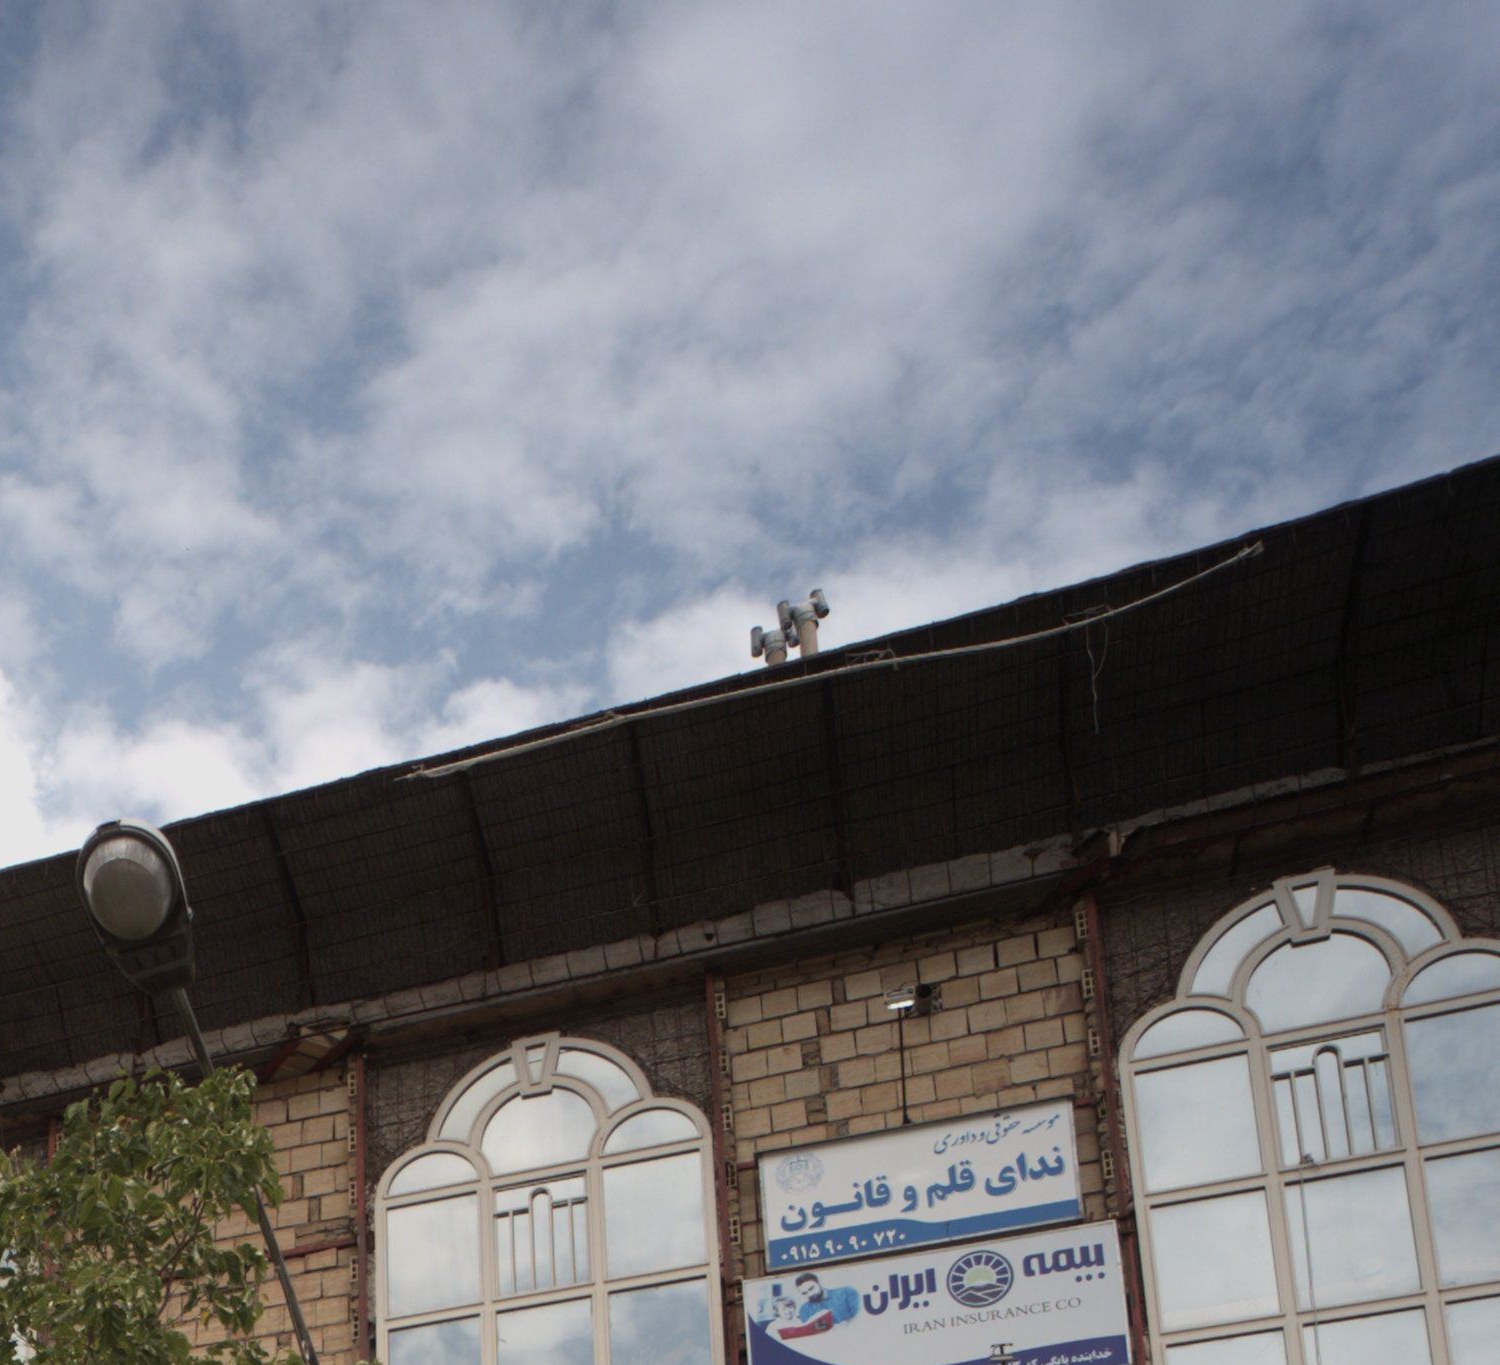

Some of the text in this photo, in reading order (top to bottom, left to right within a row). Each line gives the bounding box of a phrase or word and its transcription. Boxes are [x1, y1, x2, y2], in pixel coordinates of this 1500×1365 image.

[932, 1131, 977, 1155] داوری
[985, 1112, 1021, 1145] حقوقی
[780, 1146, 1066, 1232] ندای قلم و قانون
[780, 1244, 821, 1261] ۰۹۱۵
[824, 1238, 844, 1255] ۹۰
[848, 1235, 868, 1251] ۹۰
[862, 1243, 1106, 1316] بیمه ایران
[903, 1296, 1082, 1335] IRAN INSURANCE CO
